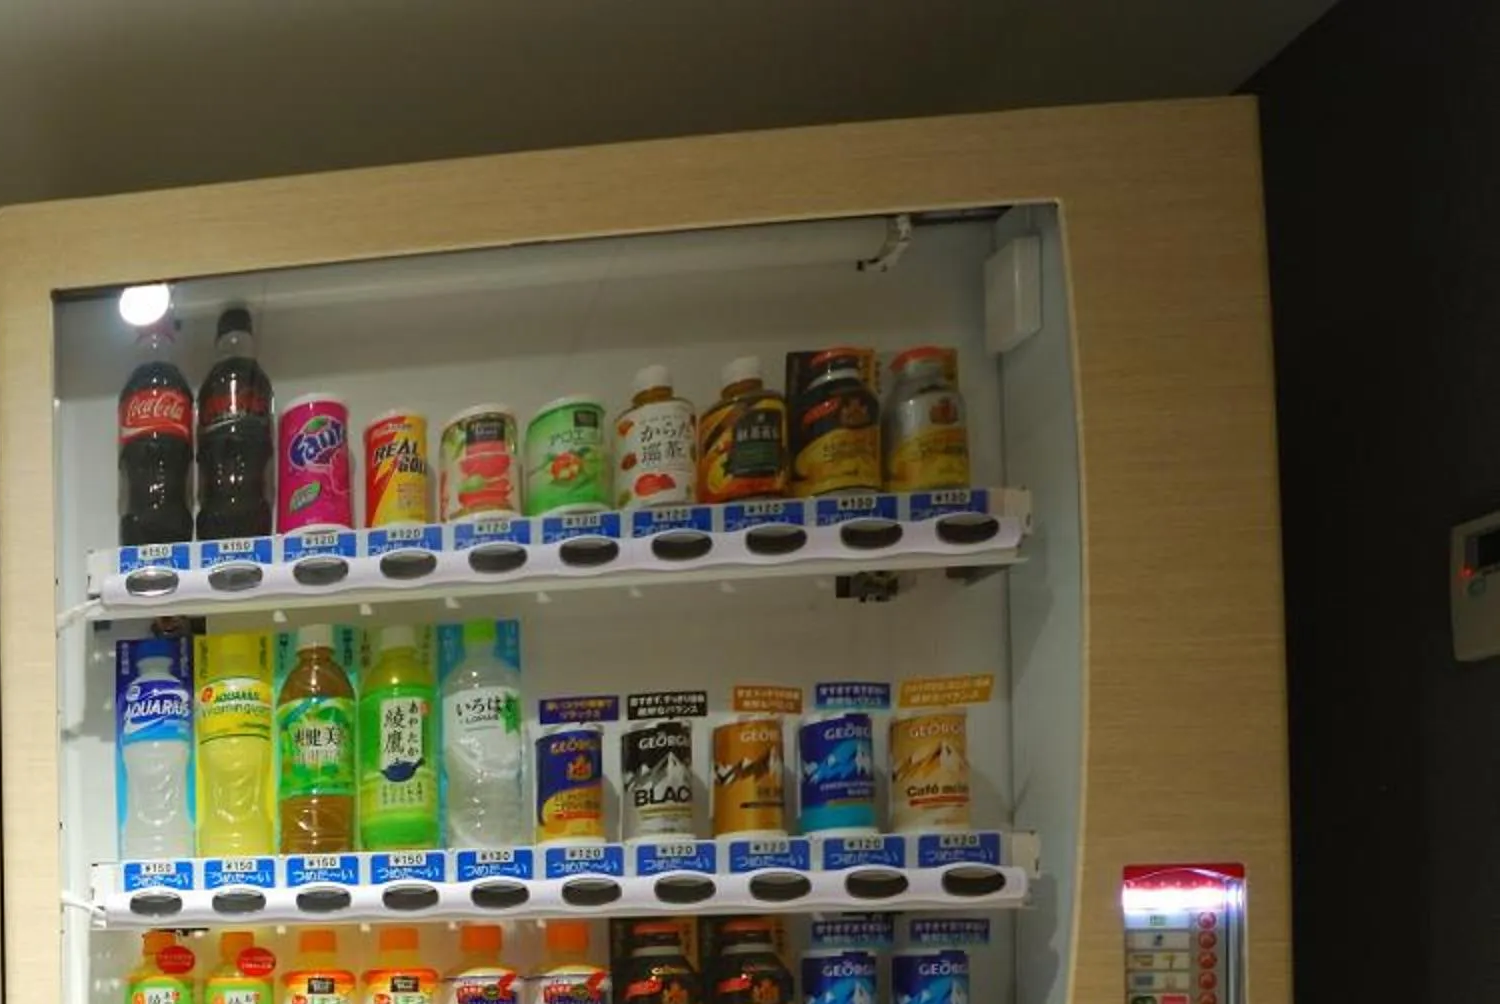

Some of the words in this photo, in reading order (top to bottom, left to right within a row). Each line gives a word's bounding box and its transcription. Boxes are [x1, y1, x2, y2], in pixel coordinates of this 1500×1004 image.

[127, 394, 184, 421] Coca-Cola
[375, 440, 419, 462] REAL
[125, 698, 190, 720] AQUARIUS
[635, 786, 693, 808] BLAC
[569, 847, 602, 859] ¥120
[661, 844, 694, 856] ¥120
[752, 841, 787, 853] ¥120
